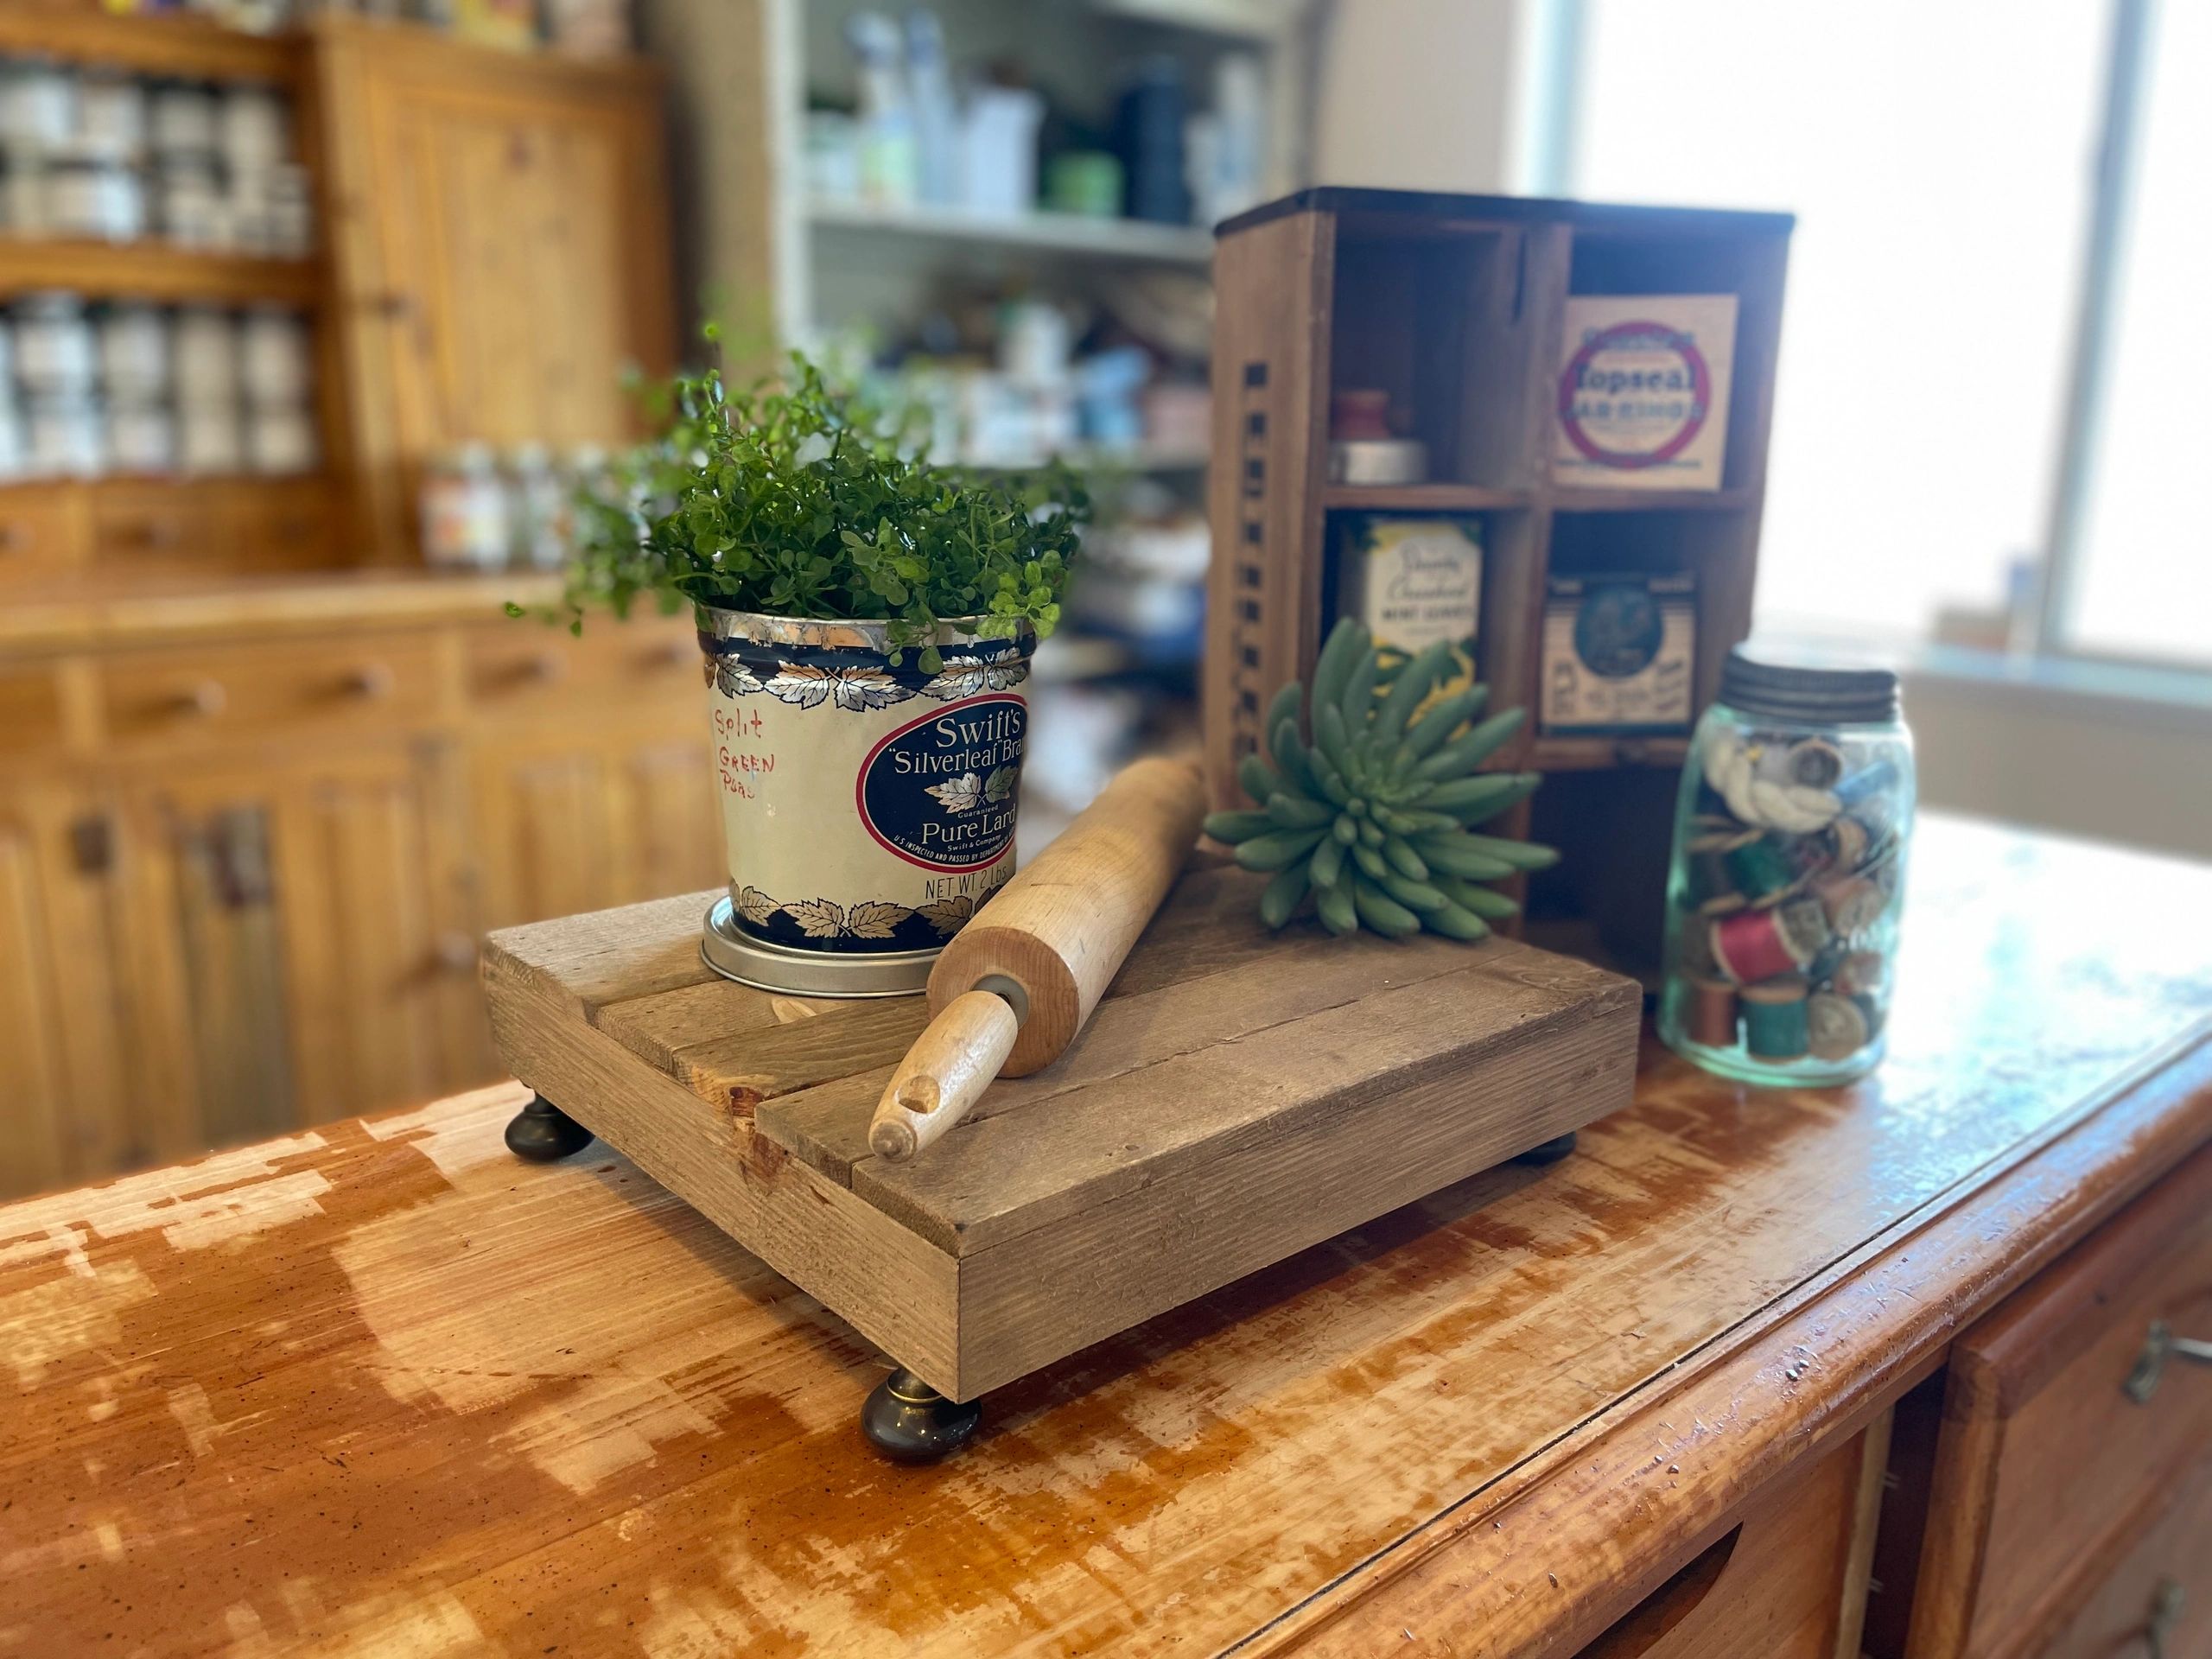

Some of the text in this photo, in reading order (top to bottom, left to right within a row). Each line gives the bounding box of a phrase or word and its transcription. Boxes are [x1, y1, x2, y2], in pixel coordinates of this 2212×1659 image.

[715, 708, 762, 741] Split
[936, 709, 1020, 747] Swift's
[719, 746, 775, 772] GREEN
[1002, 737, 1024, 761] Bra
[921, 823, 978, 844] Pure
[982, 803, 1015, 836] Lard
[957, 804, 999, 819] Guaranteed
[905, 842, 935, 859] INSPECTED
[934, 852, 948, 861] AND
[948, 854, 969, 862] PASSED
[971, 853, 979, 861] BY
[947, 842, 969, 852] Swift
[925, 877, 955, 899] NET
[980, 870, 988, 890] 2
